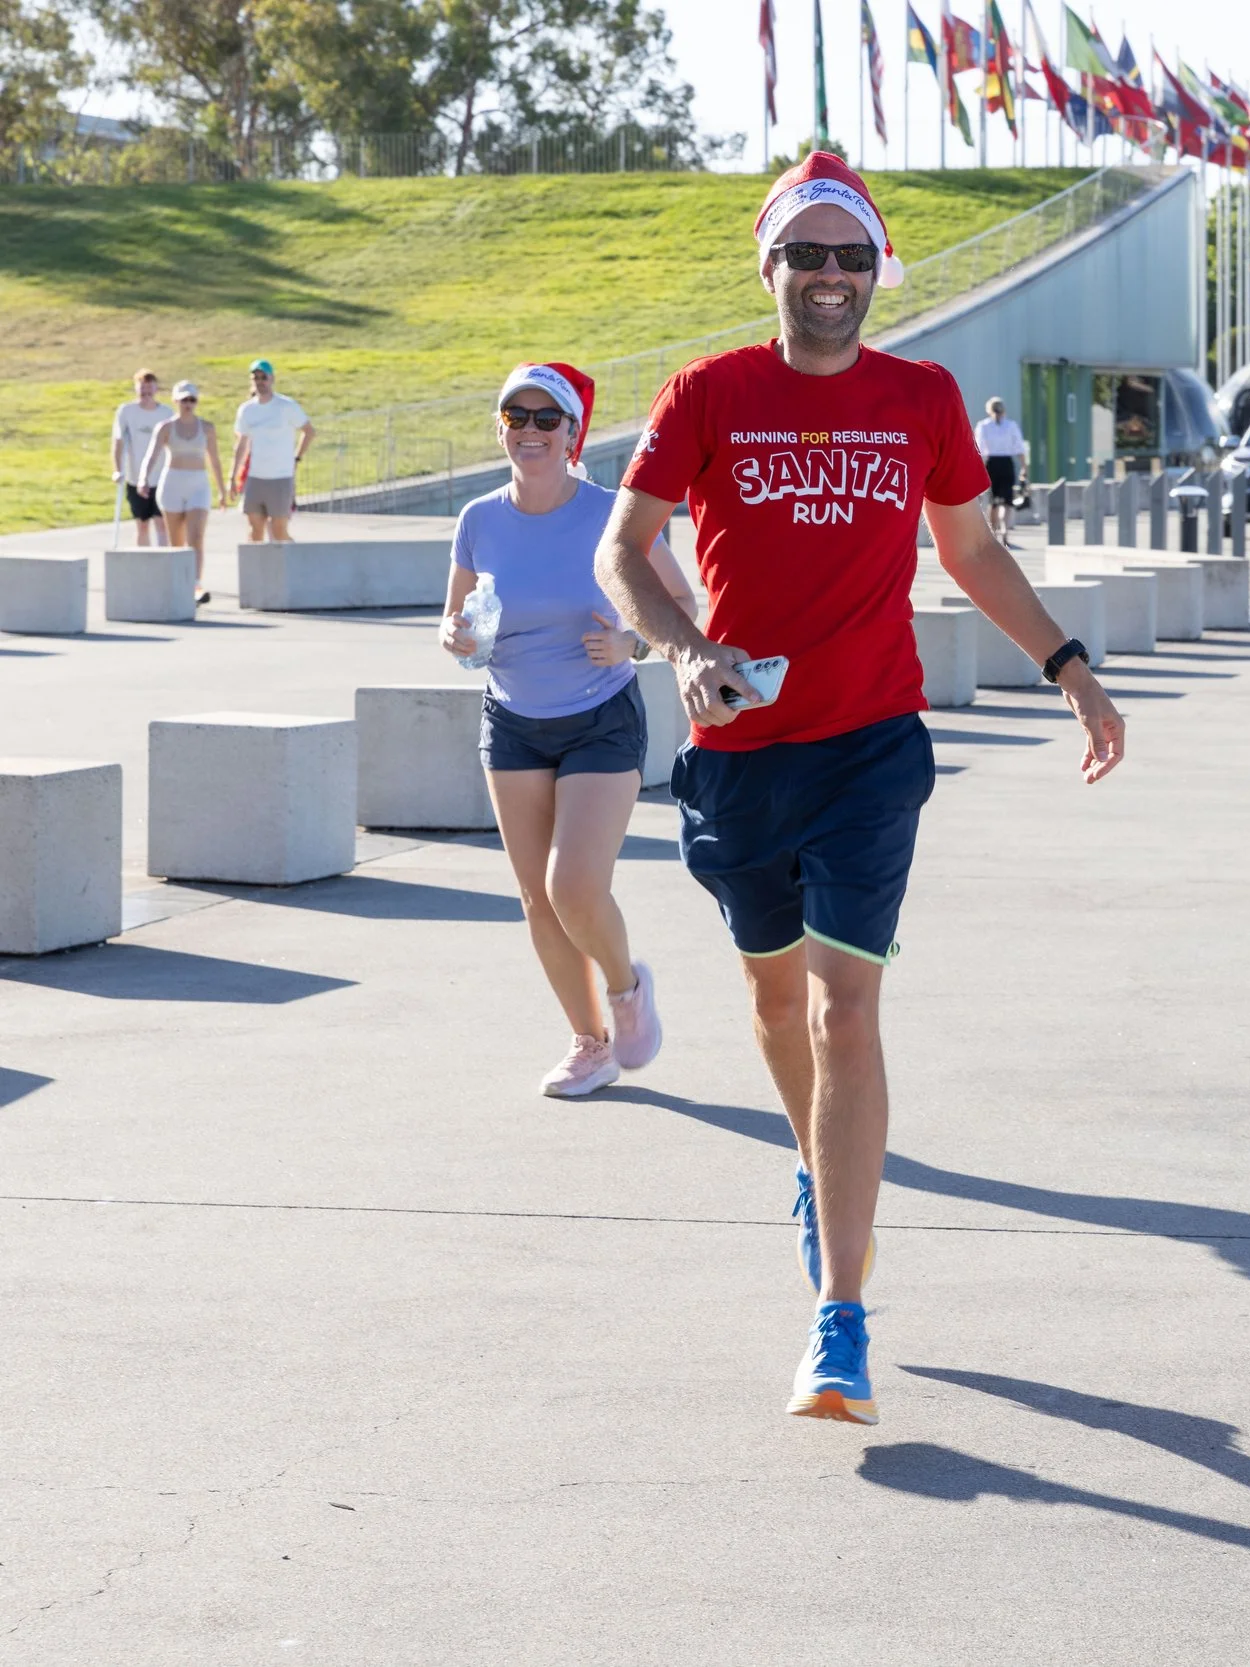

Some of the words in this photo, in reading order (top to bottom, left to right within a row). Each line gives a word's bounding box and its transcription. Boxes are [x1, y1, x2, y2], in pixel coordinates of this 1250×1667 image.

[810, 182, 853, 200] Santa
[853, 195, 872, 222] Run
[731, 432, 797, 444] RUNNING
[801, 432, 829, 444] FOR
[832, 431, 908, 444] RESILIENCE
[732, 449, 908, 511] SANTA
[793, 502, 853, 524] RUN
